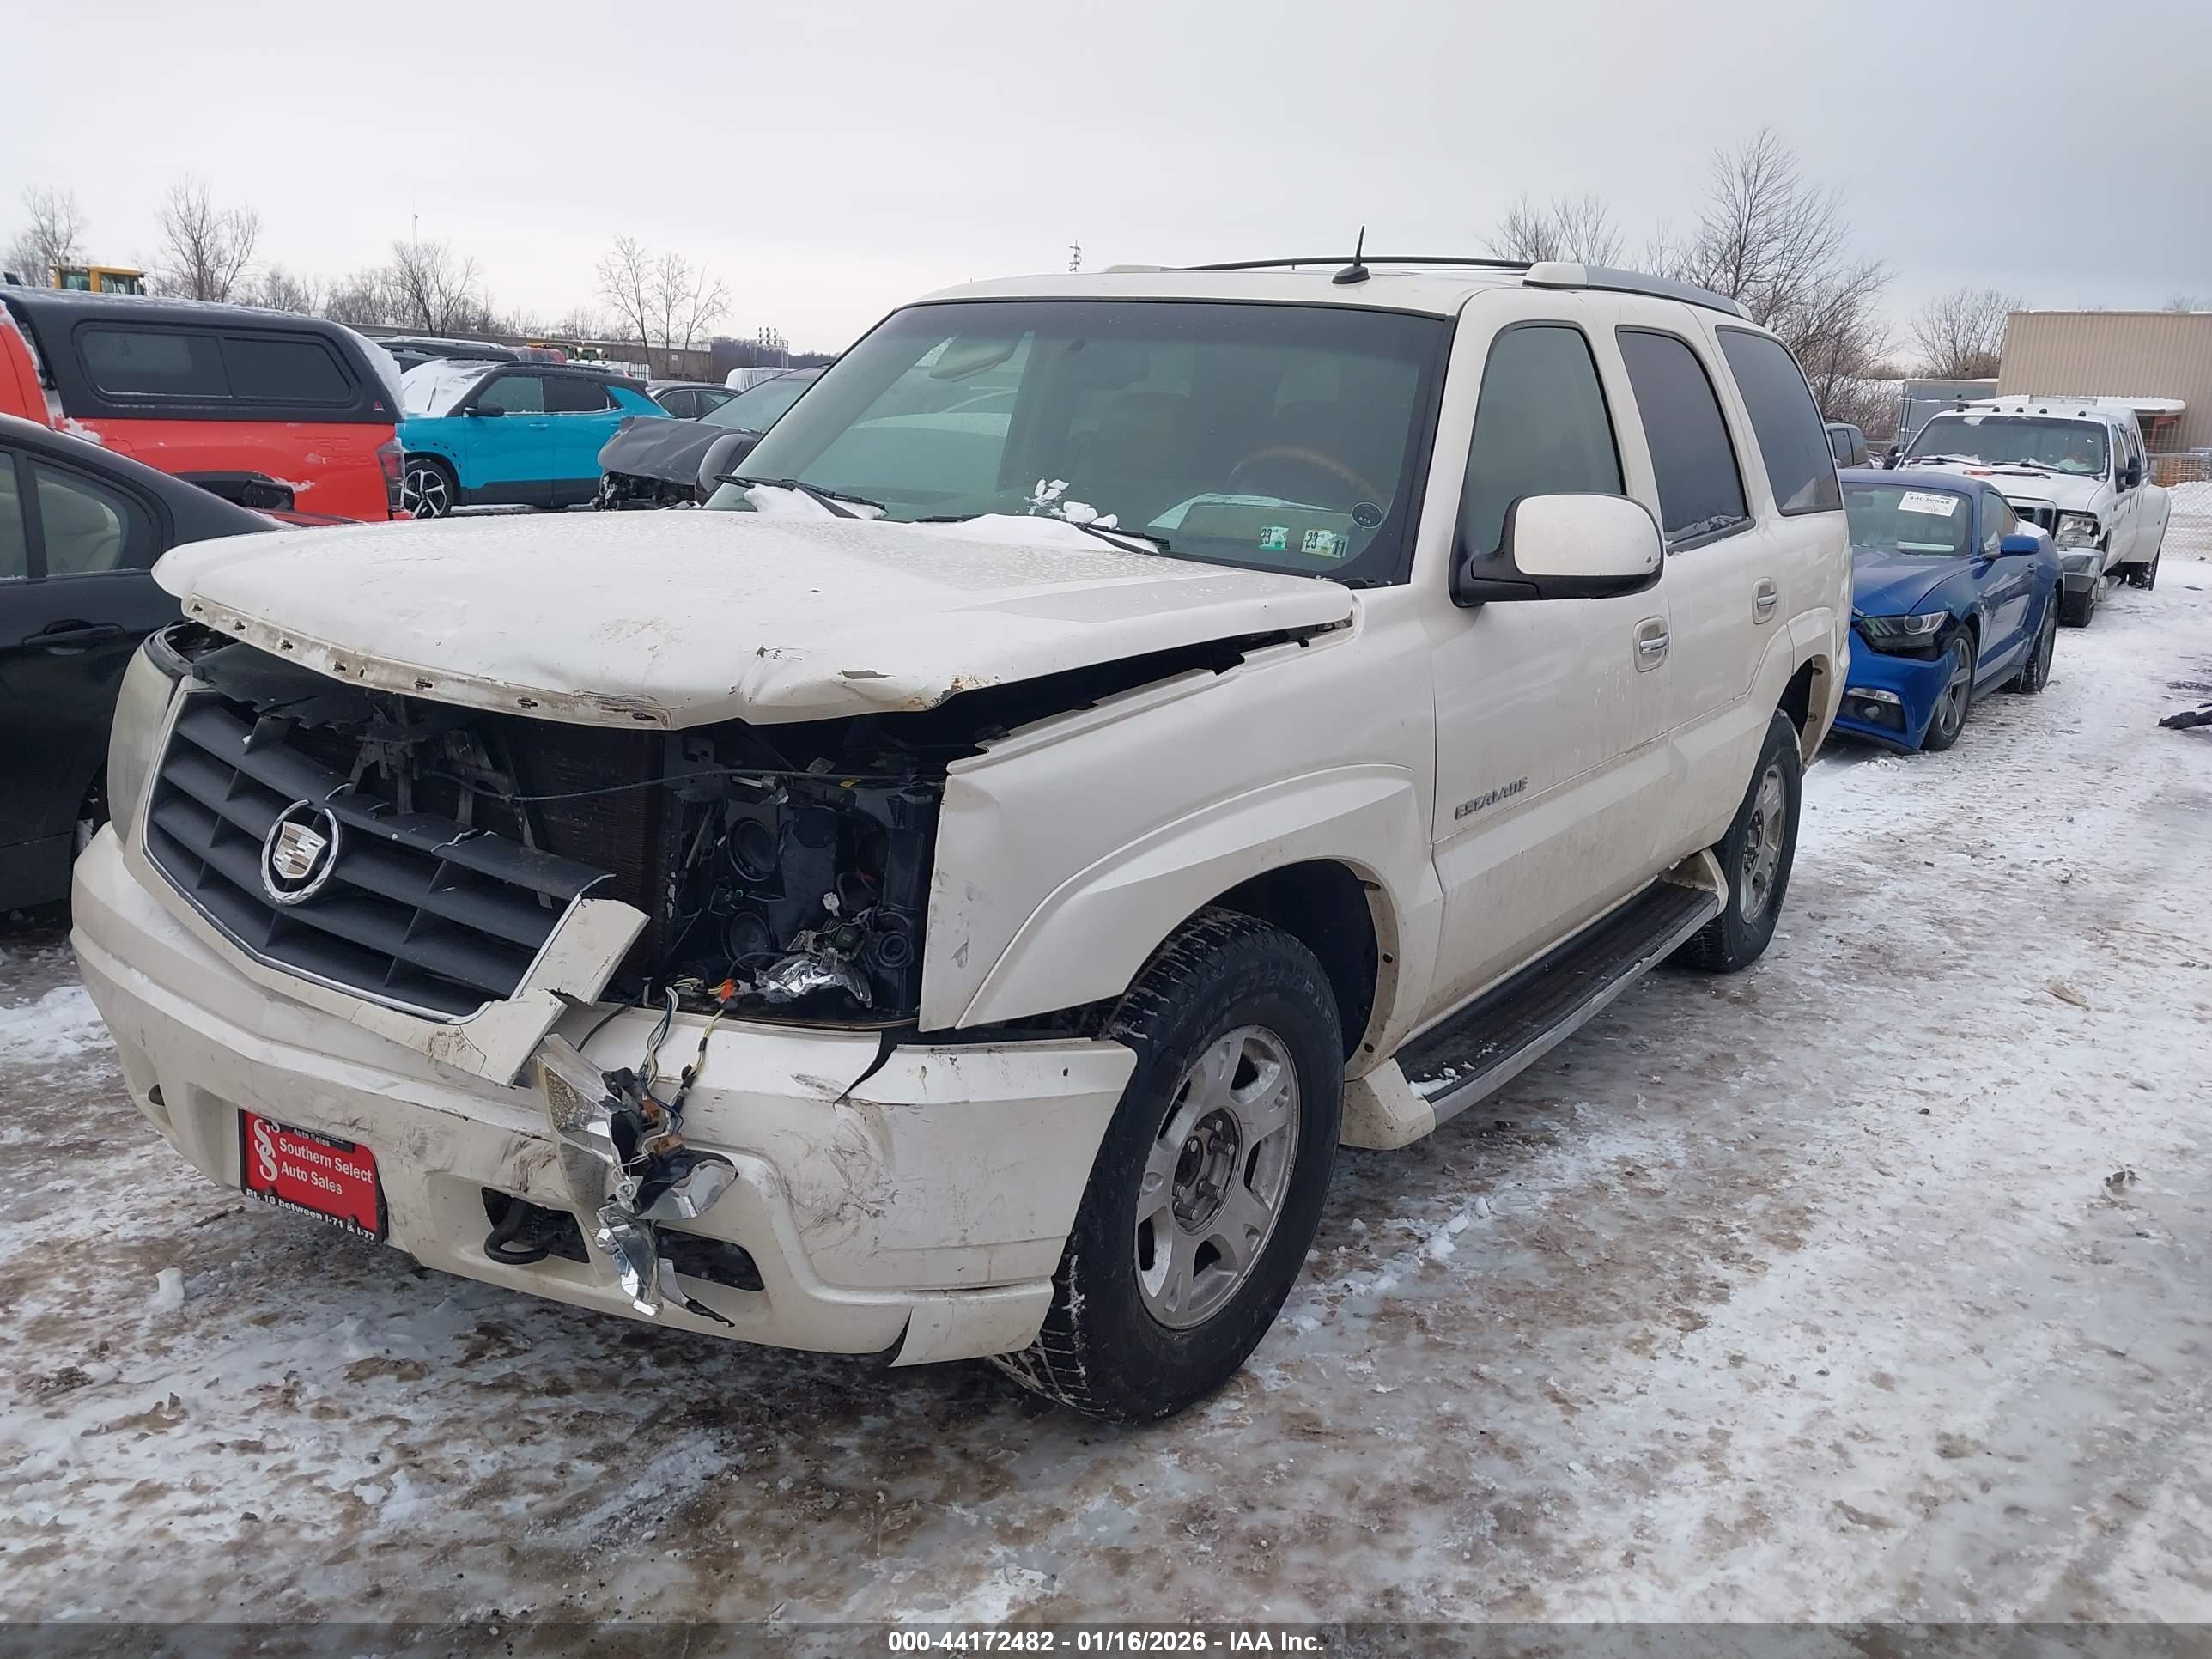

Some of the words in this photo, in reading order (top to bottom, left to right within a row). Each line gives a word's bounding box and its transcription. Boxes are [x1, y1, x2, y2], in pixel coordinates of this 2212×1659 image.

[1306, 532, 1319, 550] 23
[1455, 776, 1528, 820] ESCALADE
[294, 1128, 309, 1140] Auto
[279, 1138, 331, 1168] Southern
[334, 1157, 373, 1183] Select
[281, 1161, 307, 1182] Auto
[311, 1171, 343, 1194] Sales
[246, 1188, 260, 1200] Rt.
[264, 1195, 276, 1205] 18
[278, 1199, 323, 1221] between
[325, 1214, 343, 1229] I-71
[357, 1226, 375, 1241] I-77
